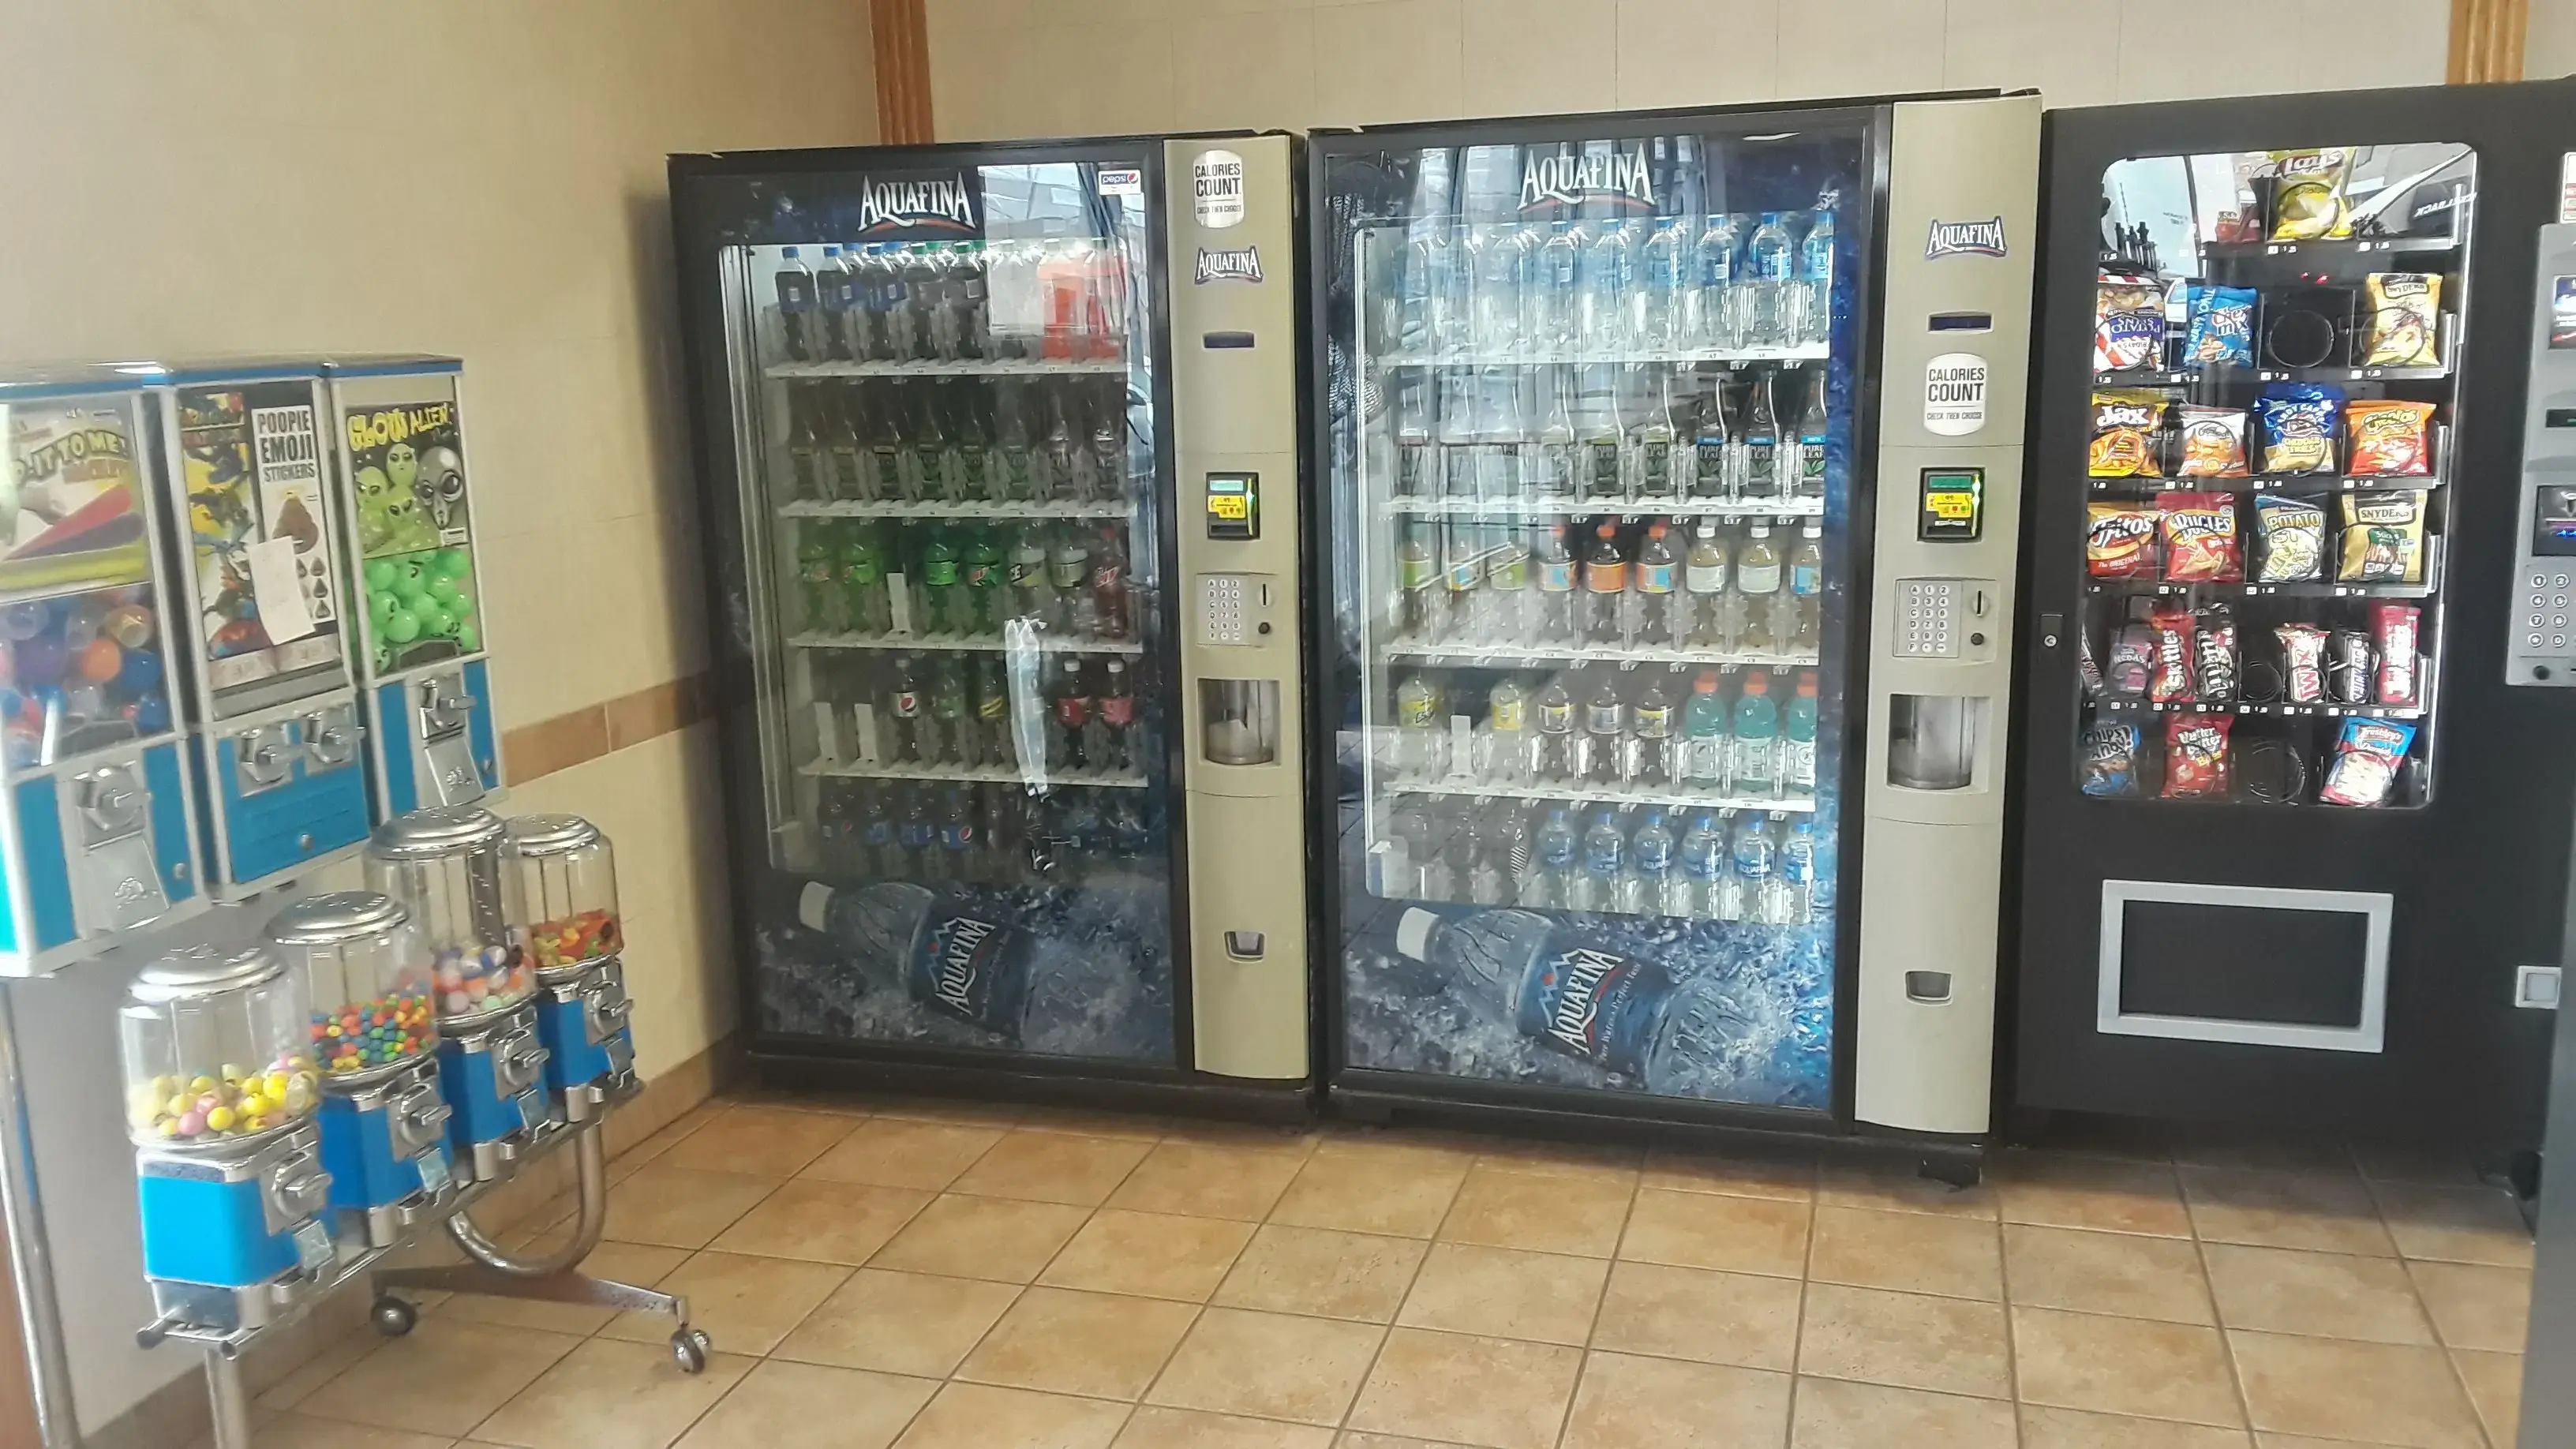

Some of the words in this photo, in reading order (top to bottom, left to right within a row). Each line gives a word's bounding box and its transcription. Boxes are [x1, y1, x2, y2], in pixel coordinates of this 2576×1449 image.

[1102, 174, 1127, 185] pepsi
[1195, 163, 1241, 178] CALORIES
[1517, 143, 1656, 211] AQUAFINA
[857, 171, 976, 231] AQUAFINA
[1926, 218, 2006, 255] AQUAFINA
[1196, 248, 1262, 280] AQUAFINA
[2110, 324, 2161, 334] POTATO
[1928, 367, 1985, 381] CALORIES
[257, 410, 311, 433] POOPIE
[346, 408, 408, 451] GLOW
[2097, 406, 2149, 426] Jax
[259, 434, 313, 463] EMOJI
[263, 463, 316, 482] STICKERS
[2267, 512, 2322, 530] POTATO
[2161, 630, 2185, 687] Skittles
[935, 916, 996, 1016] AQUAFINA
[1547, 948, 1624, 1054] AQUAFINA
